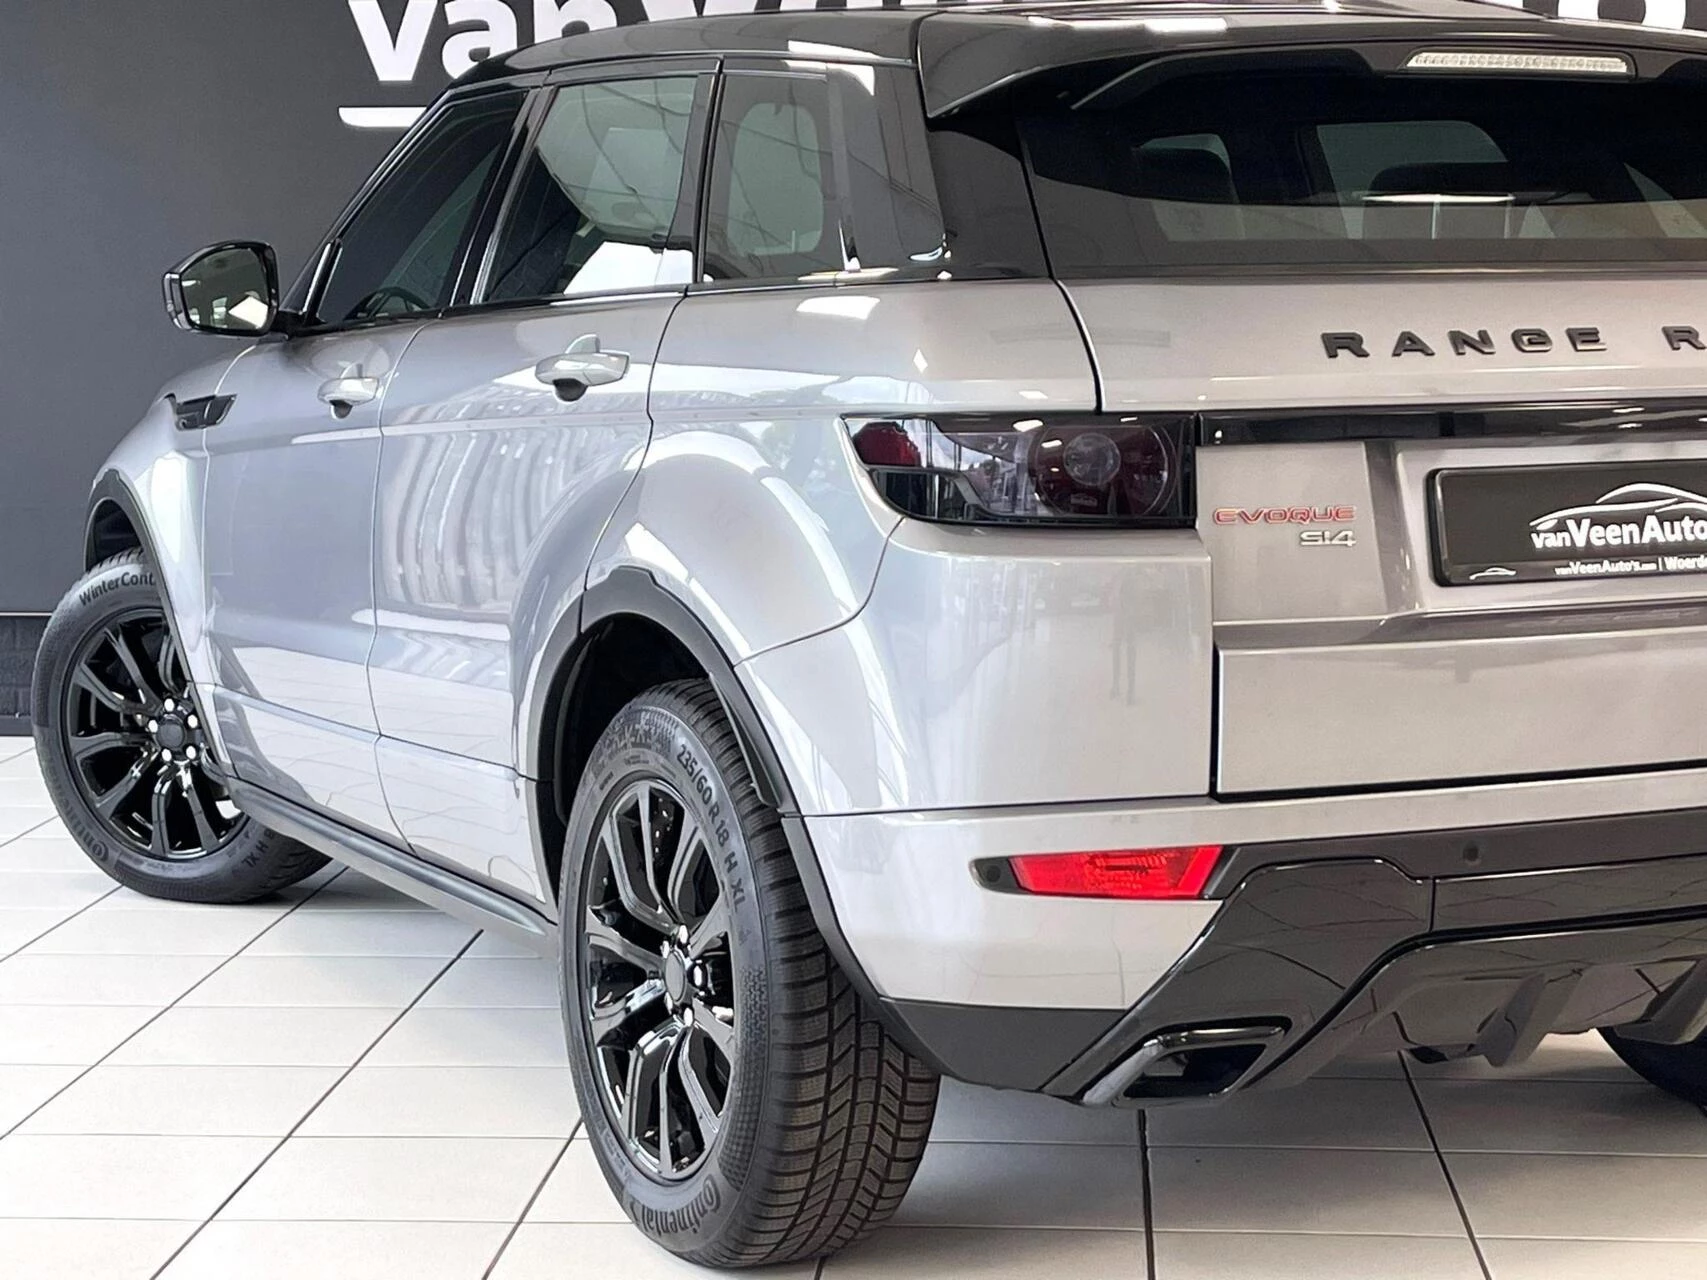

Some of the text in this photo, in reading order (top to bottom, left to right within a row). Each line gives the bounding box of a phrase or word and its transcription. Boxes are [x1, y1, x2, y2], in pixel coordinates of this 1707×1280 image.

[1321, 327, 1608, 358] RANGE
[1213, 506, 1357, 525] EVOQUE
[50, 757, 110, 864] Contine
[677, 744, 713, 805] 235/60
[724, 851, 738, 873] H
[731, 878, 746, 914] XL
[641, 1173, 721, 1237] Continental
